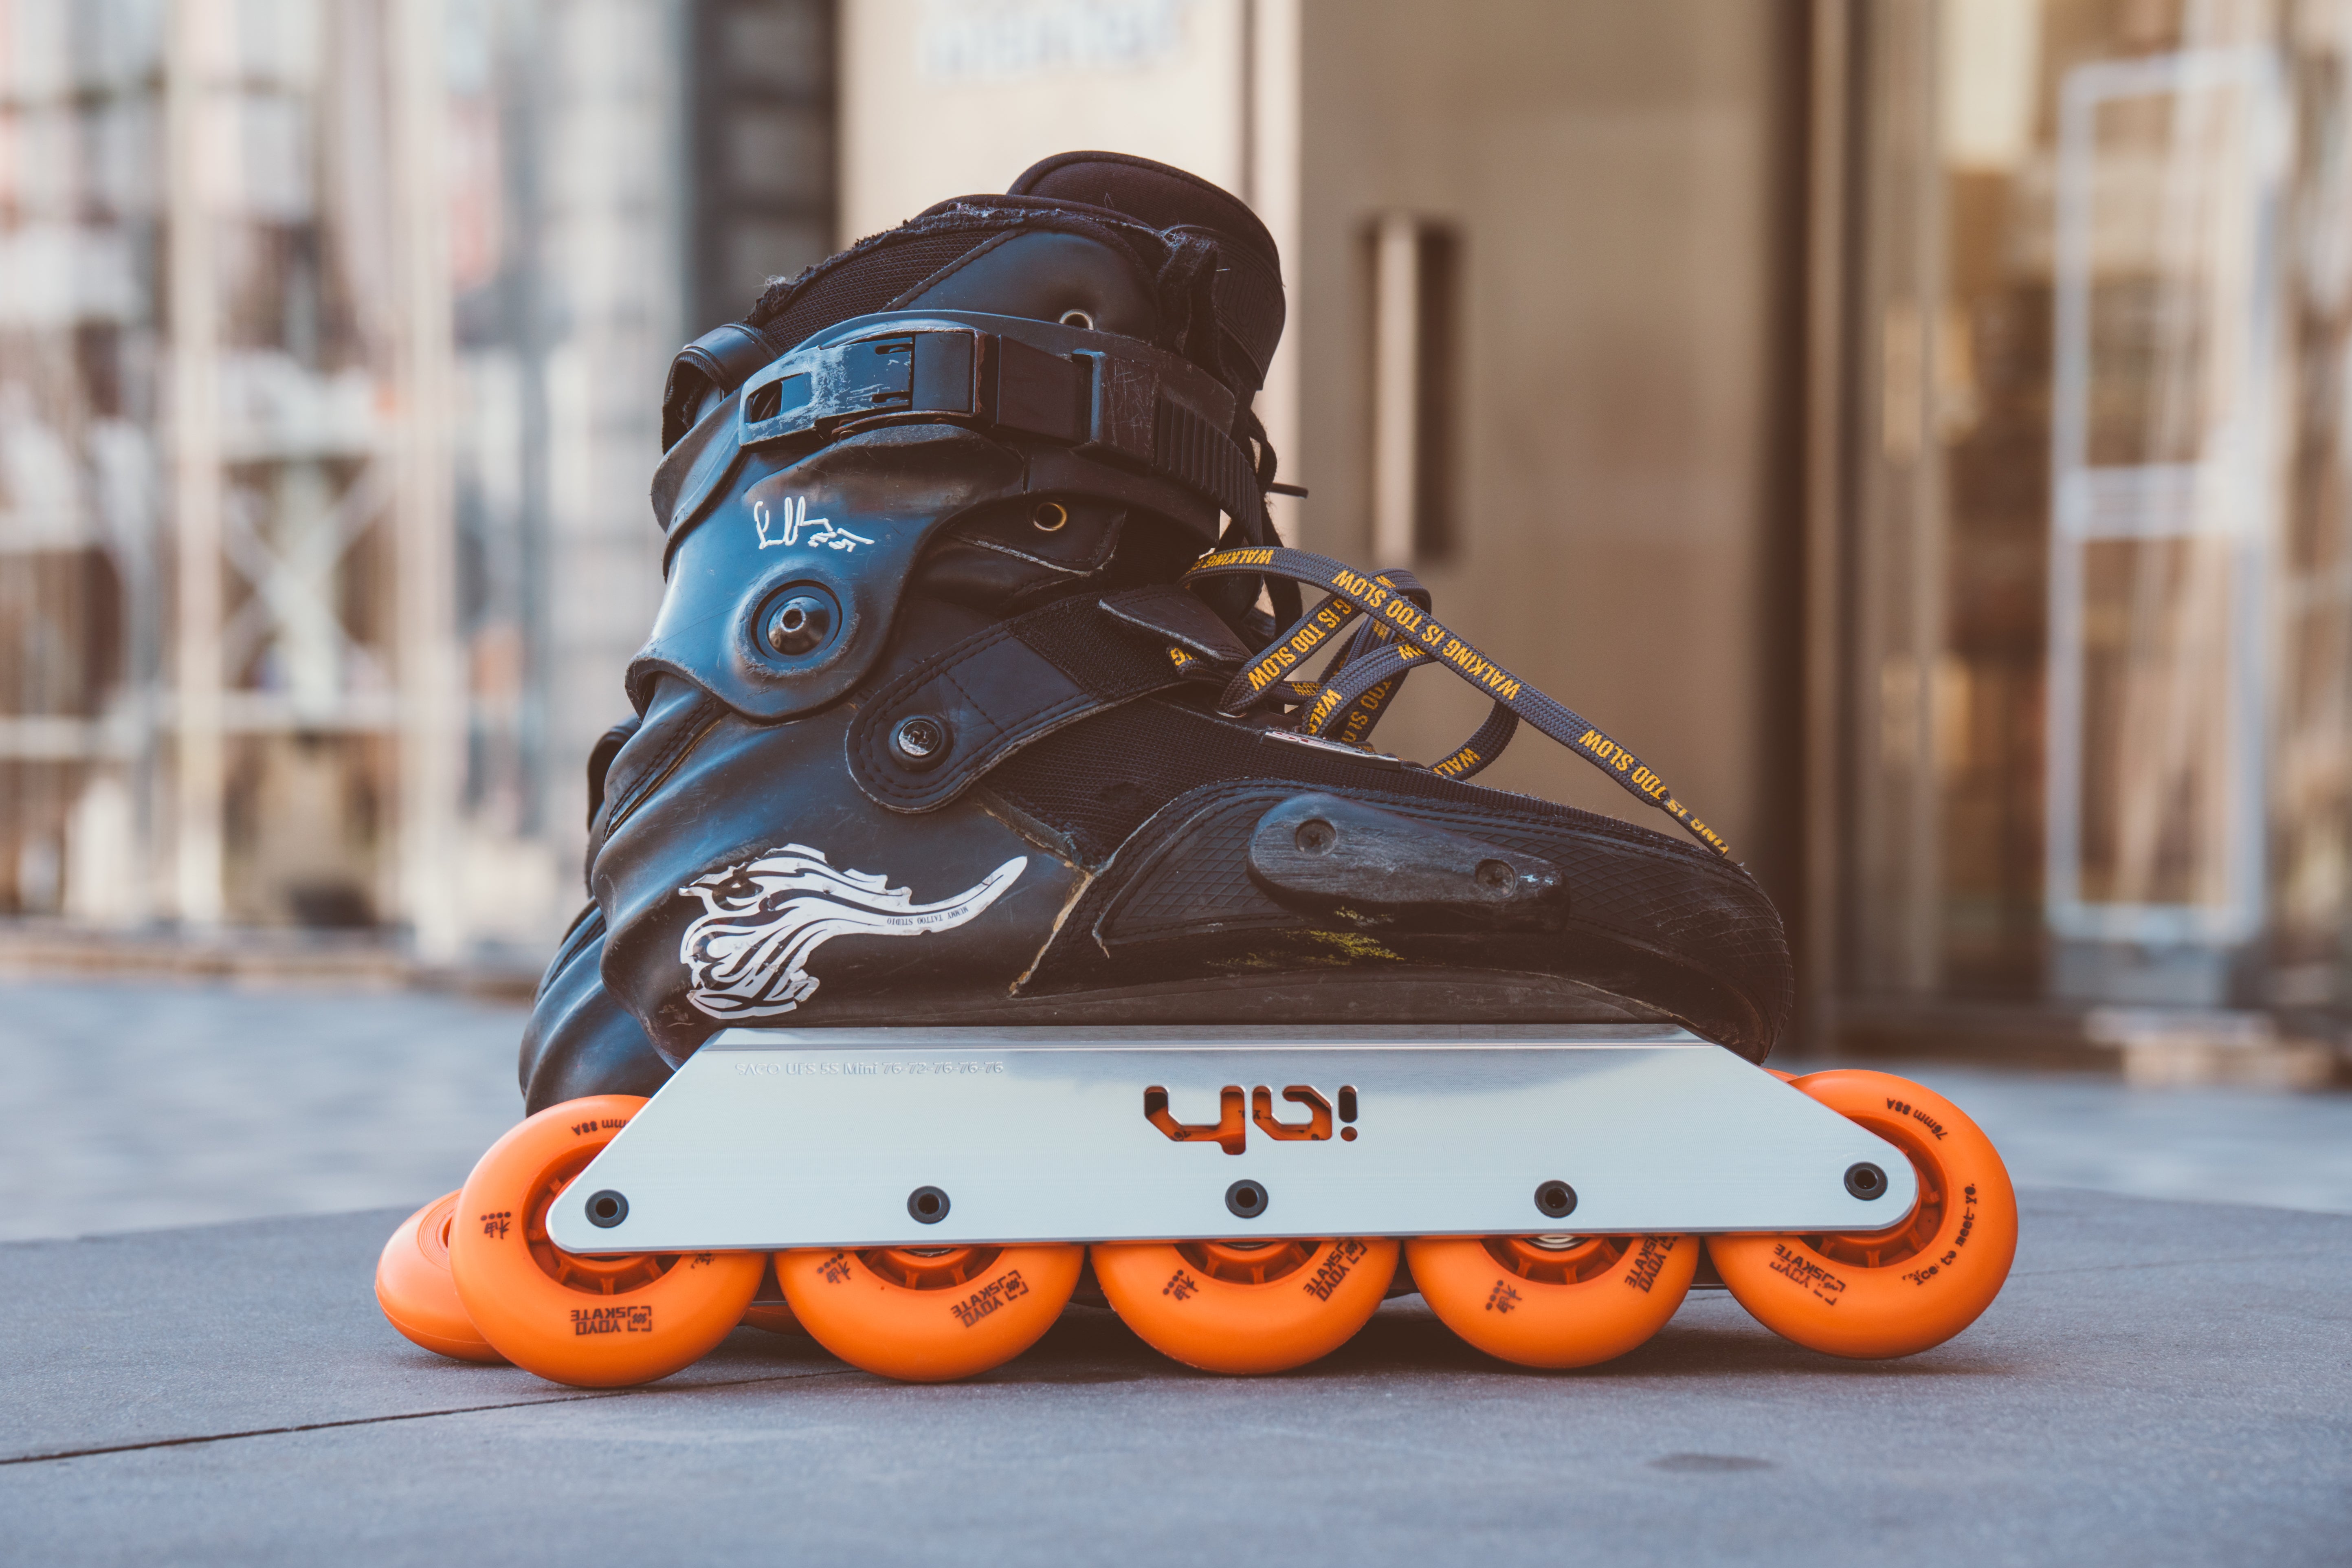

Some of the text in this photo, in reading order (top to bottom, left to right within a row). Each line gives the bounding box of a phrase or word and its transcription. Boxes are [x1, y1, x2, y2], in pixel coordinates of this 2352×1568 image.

[1202, 550, 1273, 568] WALKING
[1333, 571, 1387, 607] SLOW
[1317, 608, 1340, 629] IS
[1385, 600, 1422, 633] TOO
[1291, 623, 1326, 653] TOO
[1421, 625, 1445, 646] IS
[1248, 647, 1296, 691] SLOW
[1443, 639, 1520, 700] WALKING
[1433, 748, 1480, 775] WAL
[1579, 730, 1634, 771] SLOW
[1631, 766, 1667, 800] TOO
[887, 906, 969, 926] MUMMY TATTOO STUDIO
[786, 1062, 816, 1075] UFS
[820, 1062, 839, 1075] 5S
[843, 1061, 877, 1075] Mini
[882, 1061, 1003, 1074] 76-72-76-76-76
[571, 1119, 630, 1136] mm 88A
[1886, 1098, 1948, 1141] 76mm 88A
[1303, 1251, 1342, 1296] SKATE
[1624, 1238, 1656, 1288] SKATE
[1638, 1253, 1666, 1293] YOYO
[1774, 1243, 1824, 1280] SKATE
[1316, 1264, 1350, 1302] YOYO
[571, 1306, 626, 1321] SKATE
[951, 1284, 1000, 1317] SKATE
[962, 1297, 1003, 1328] YOYO
[575, 1322, 621, 1335] YOYO
